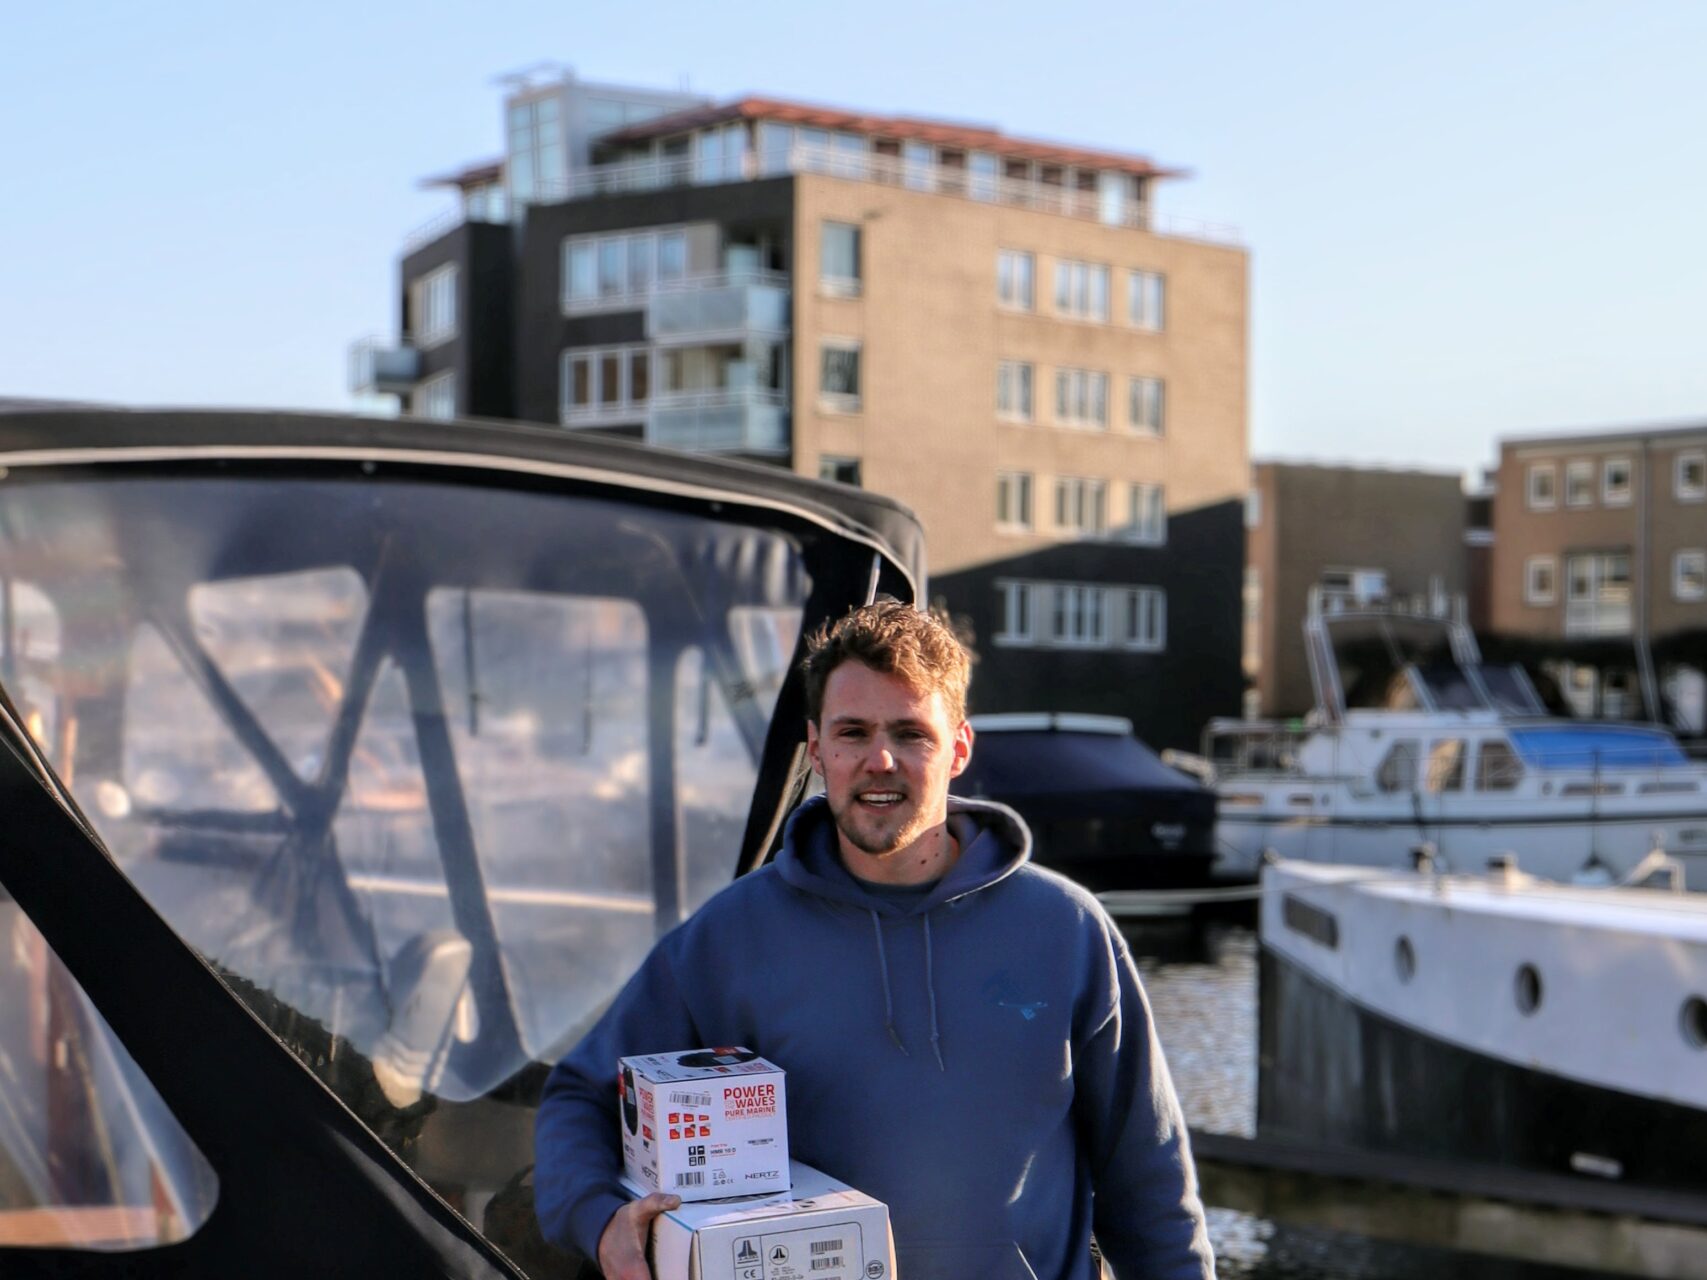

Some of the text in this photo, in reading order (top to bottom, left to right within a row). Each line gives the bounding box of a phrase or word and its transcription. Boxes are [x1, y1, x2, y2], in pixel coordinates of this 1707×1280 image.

[724, 1084, 774, 1100] POWER
[735, 1096, 775, 1108] WAVES
[725, 1108, 744, 1117] PURE
[747, 1106, 776, 1115] MARINE
[745, 1170, 780, 1180] HERTZ
